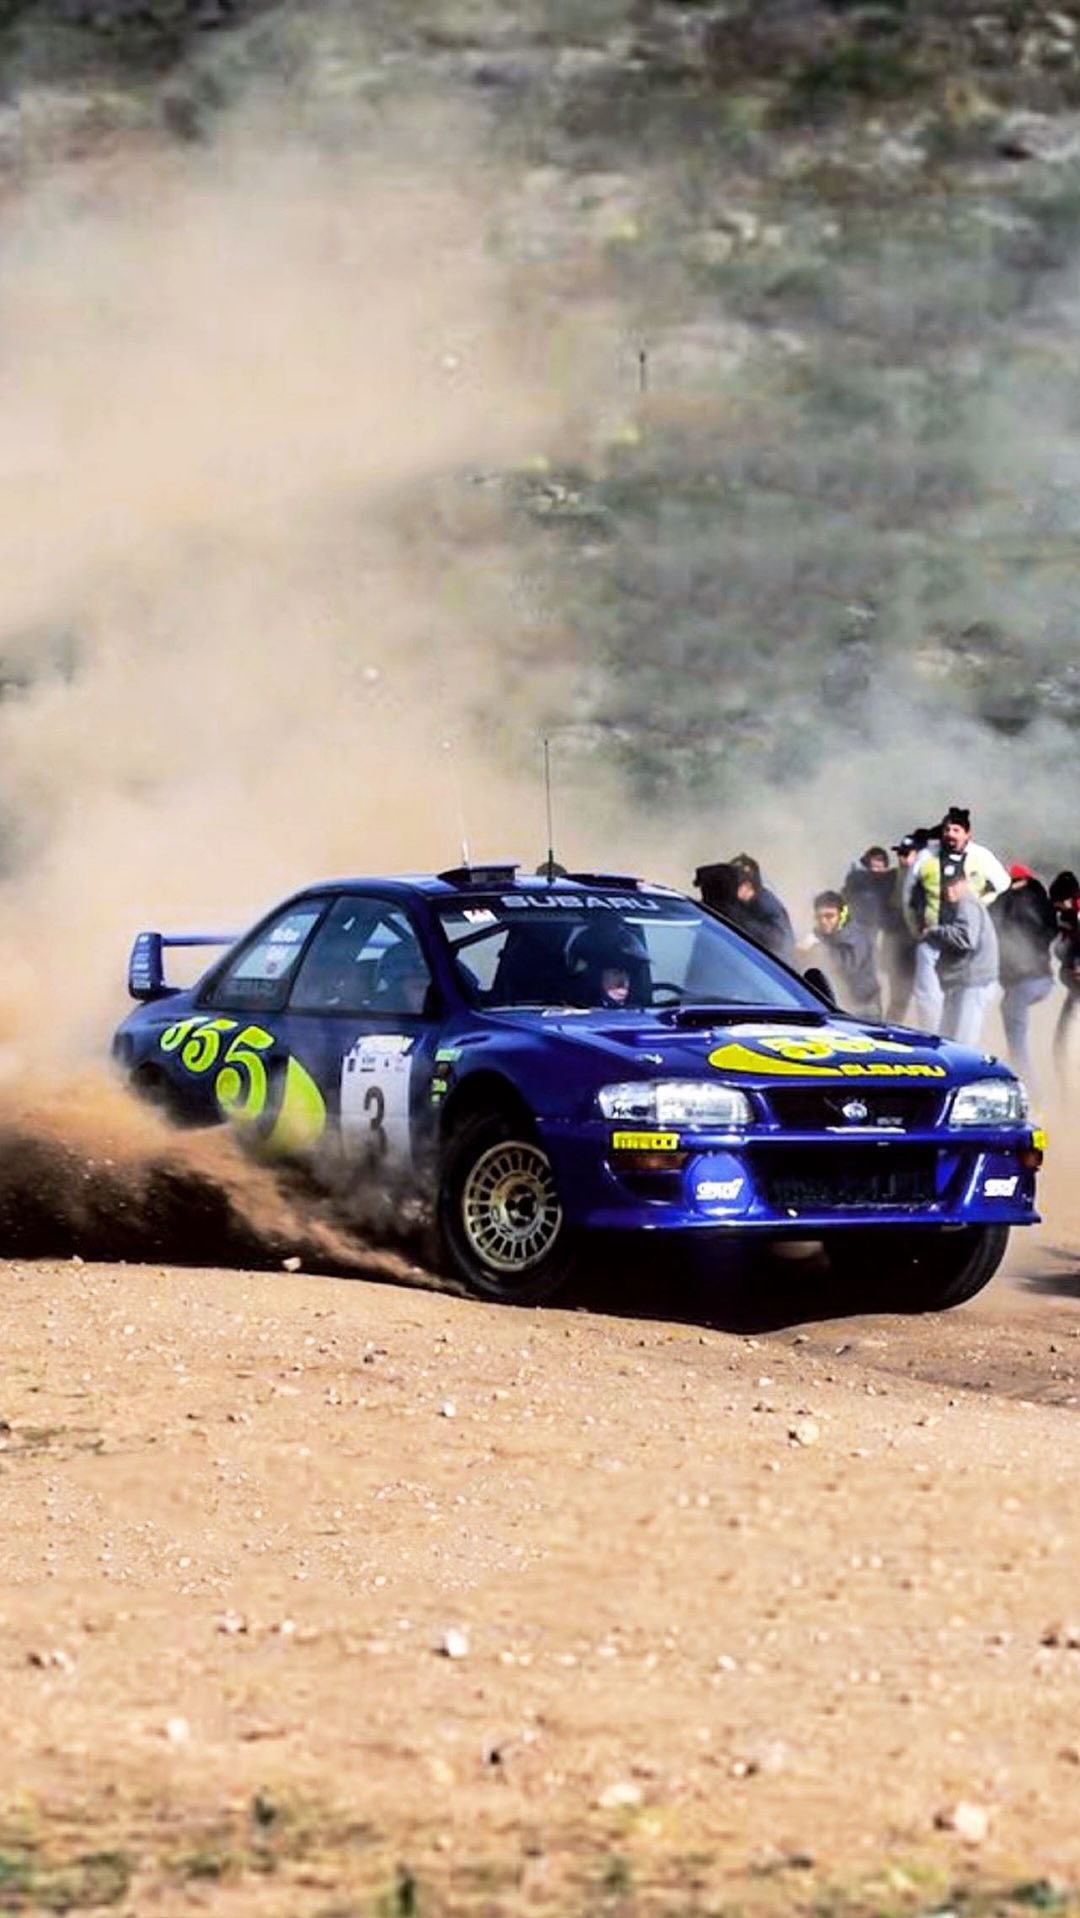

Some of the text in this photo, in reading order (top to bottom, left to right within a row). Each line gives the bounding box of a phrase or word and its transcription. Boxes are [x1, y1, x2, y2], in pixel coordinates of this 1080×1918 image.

[501, 895, 660, 911] SUBARU
[160, 1016, 275, 1122] 555
[840, 1063, 946, 1077] SUBARU
